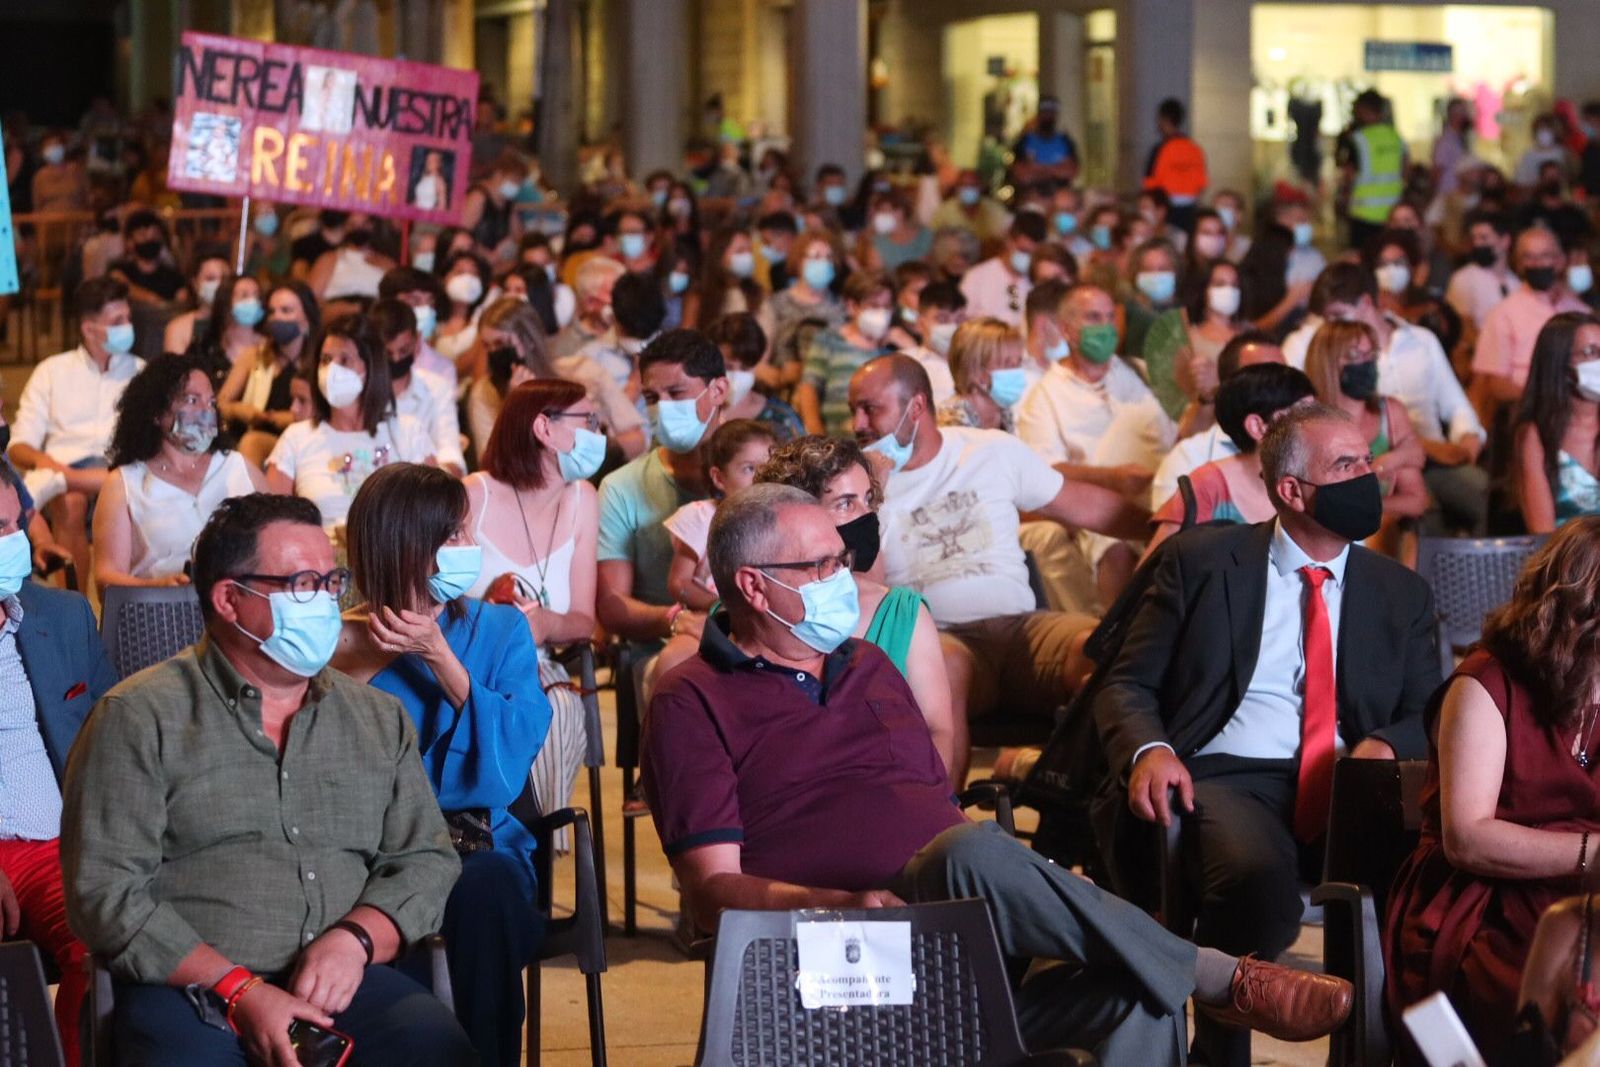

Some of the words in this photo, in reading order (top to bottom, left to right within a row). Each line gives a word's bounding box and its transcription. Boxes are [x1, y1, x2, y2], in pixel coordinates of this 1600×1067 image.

[177, 46, 303, 114] NEREA
[352, 84, 473, 141] NUESTRA
[251, 126, 398, 206] REINA
[820, 989, 890, 999] Presentadra
